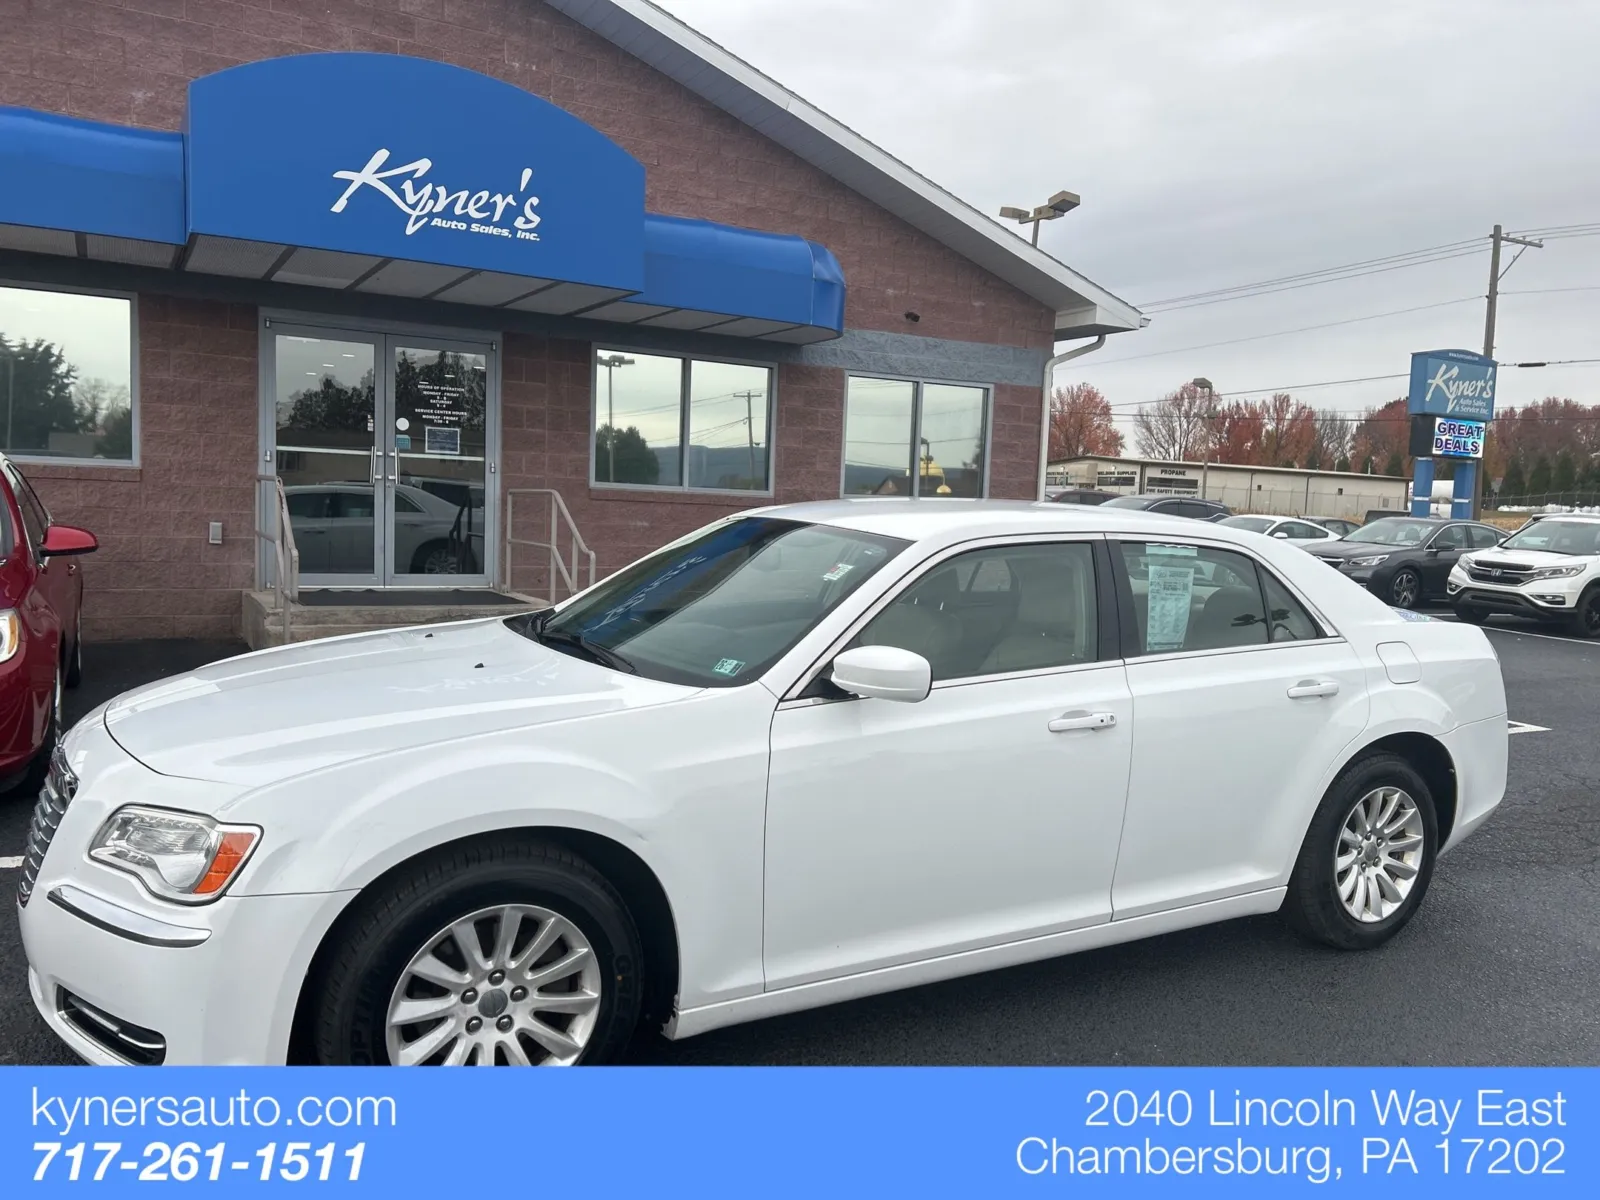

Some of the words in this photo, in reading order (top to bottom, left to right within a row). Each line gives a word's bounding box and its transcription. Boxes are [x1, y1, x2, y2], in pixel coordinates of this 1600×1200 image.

[330, 148, 541, 236] Kyner's
[430, 217, 467, 230] Auto
[470, 223, 512, 238] Sales,
[516, 230, 540, 241] Inc.
[1425, 363, 1493, 414] Kyner's
[1437, 421, 1483, 438] GREAT
[1434, 437, 1479, 453] DEALS
[1160, 469, 1187, 477] PROPANE
